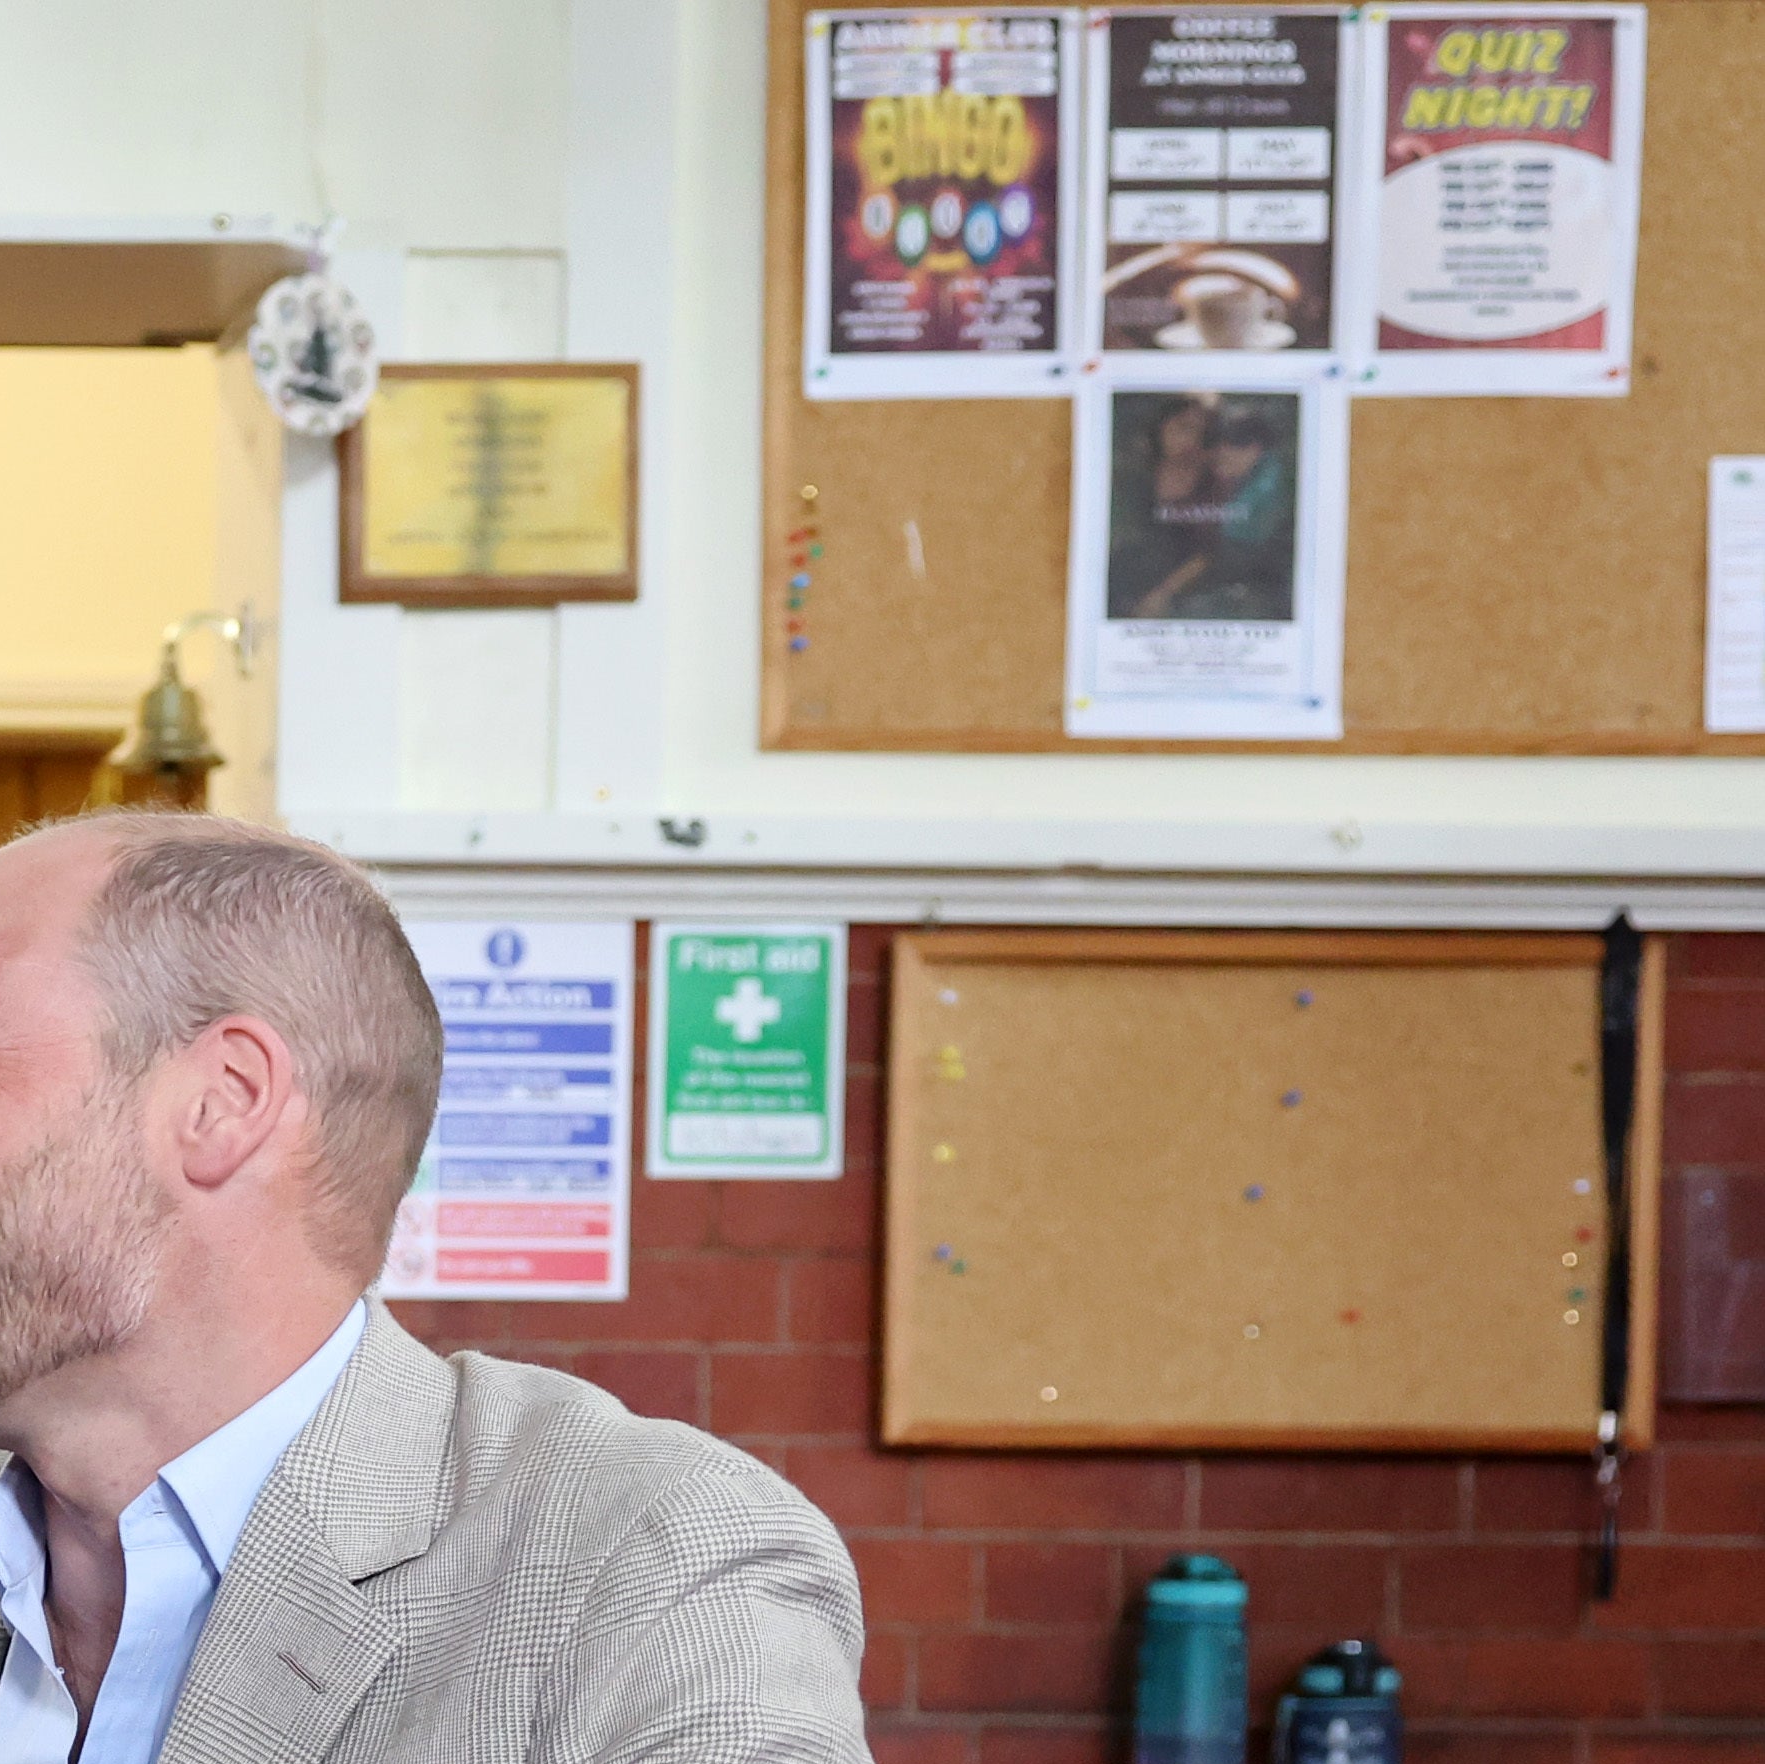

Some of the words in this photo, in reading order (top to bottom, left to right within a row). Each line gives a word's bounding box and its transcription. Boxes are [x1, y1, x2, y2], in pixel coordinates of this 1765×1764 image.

[1151, 40, 1298, 63] MORNINGS
[1435, 28, 1568, 76] QUIZ
[1402, 84, 1595, 130] NIGHT!
[857, 88, 1032, 187] BINGO
[678, 940, 759, 973] First
[765, 940, 823, 973] aid
[485, 979, 592, 1008] Action
